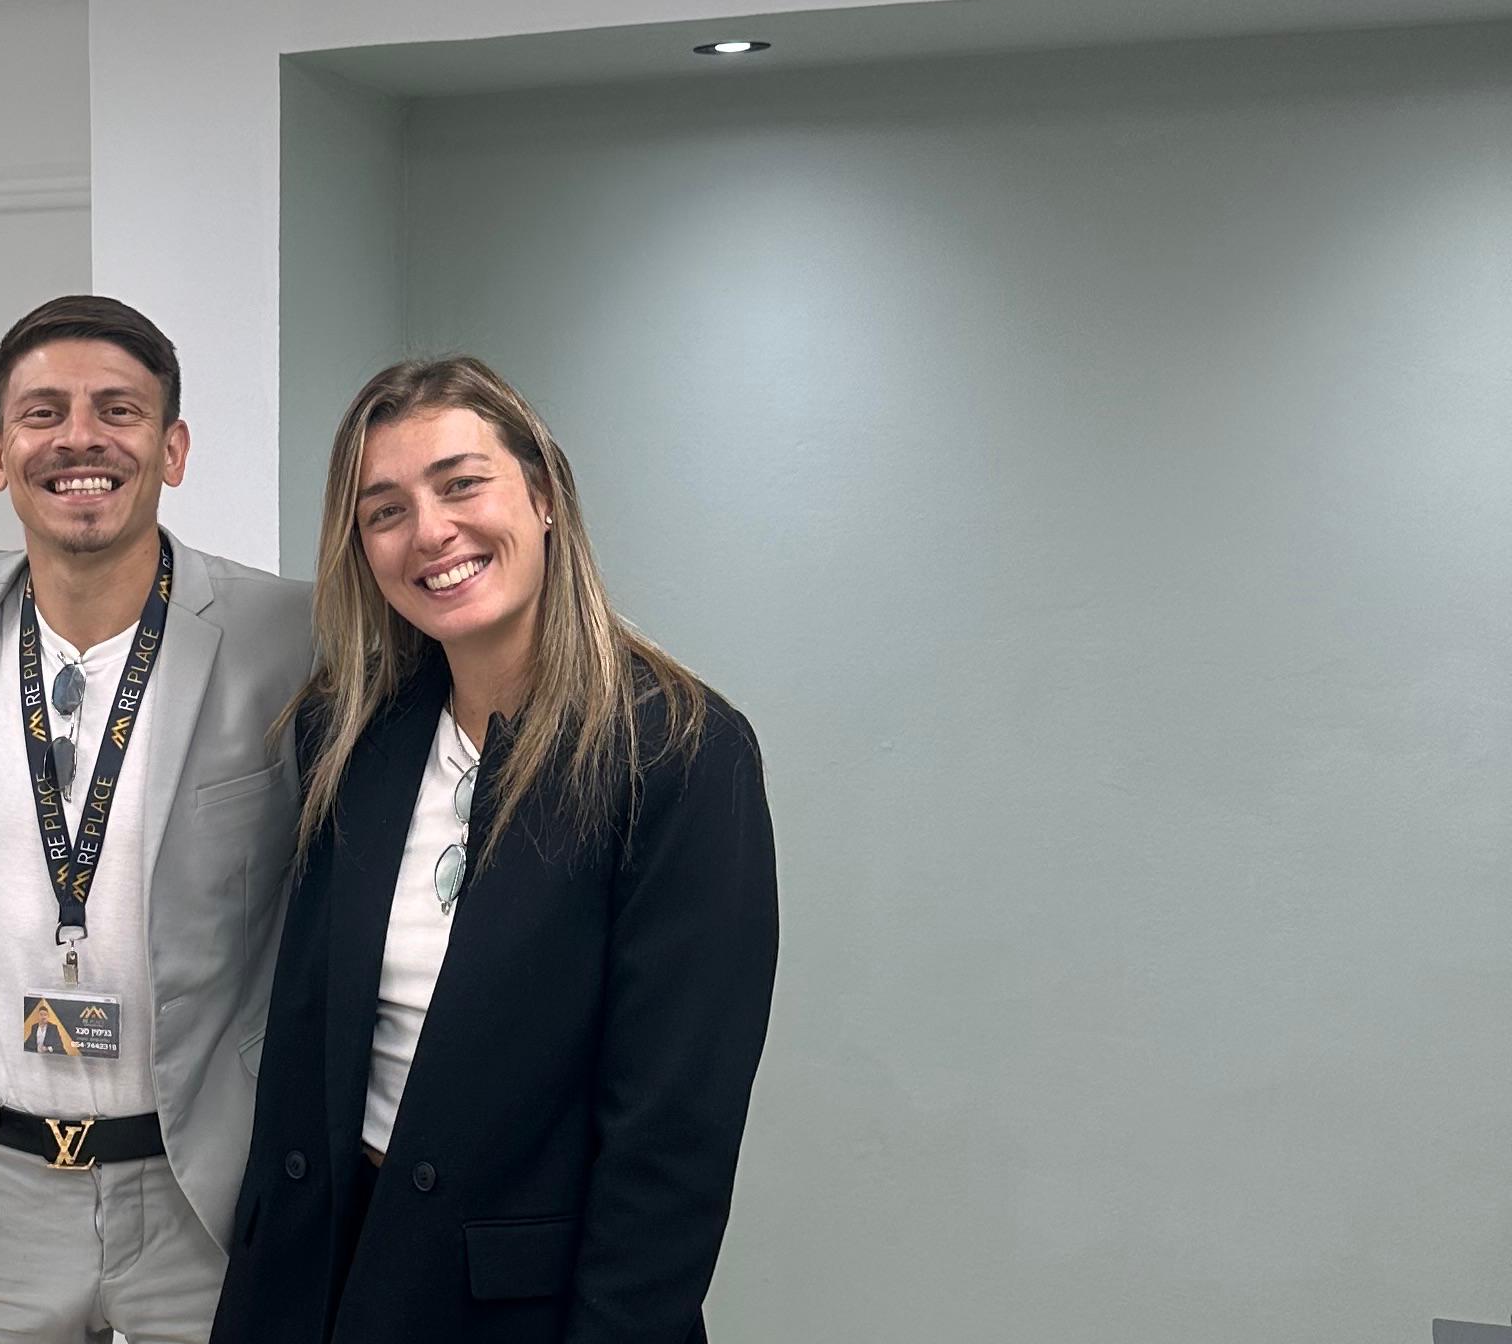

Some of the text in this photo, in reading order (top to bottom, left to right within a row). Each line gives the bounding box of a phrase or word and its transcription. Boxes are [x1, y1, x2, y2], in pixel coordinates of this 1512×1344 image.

[22, 623, 42, 707] RE PLACE
[118, 625, 160, 712] RE PLACE
[47, 834, 69, 861] RE
[76, 775, 114, 866] RE PLACE
